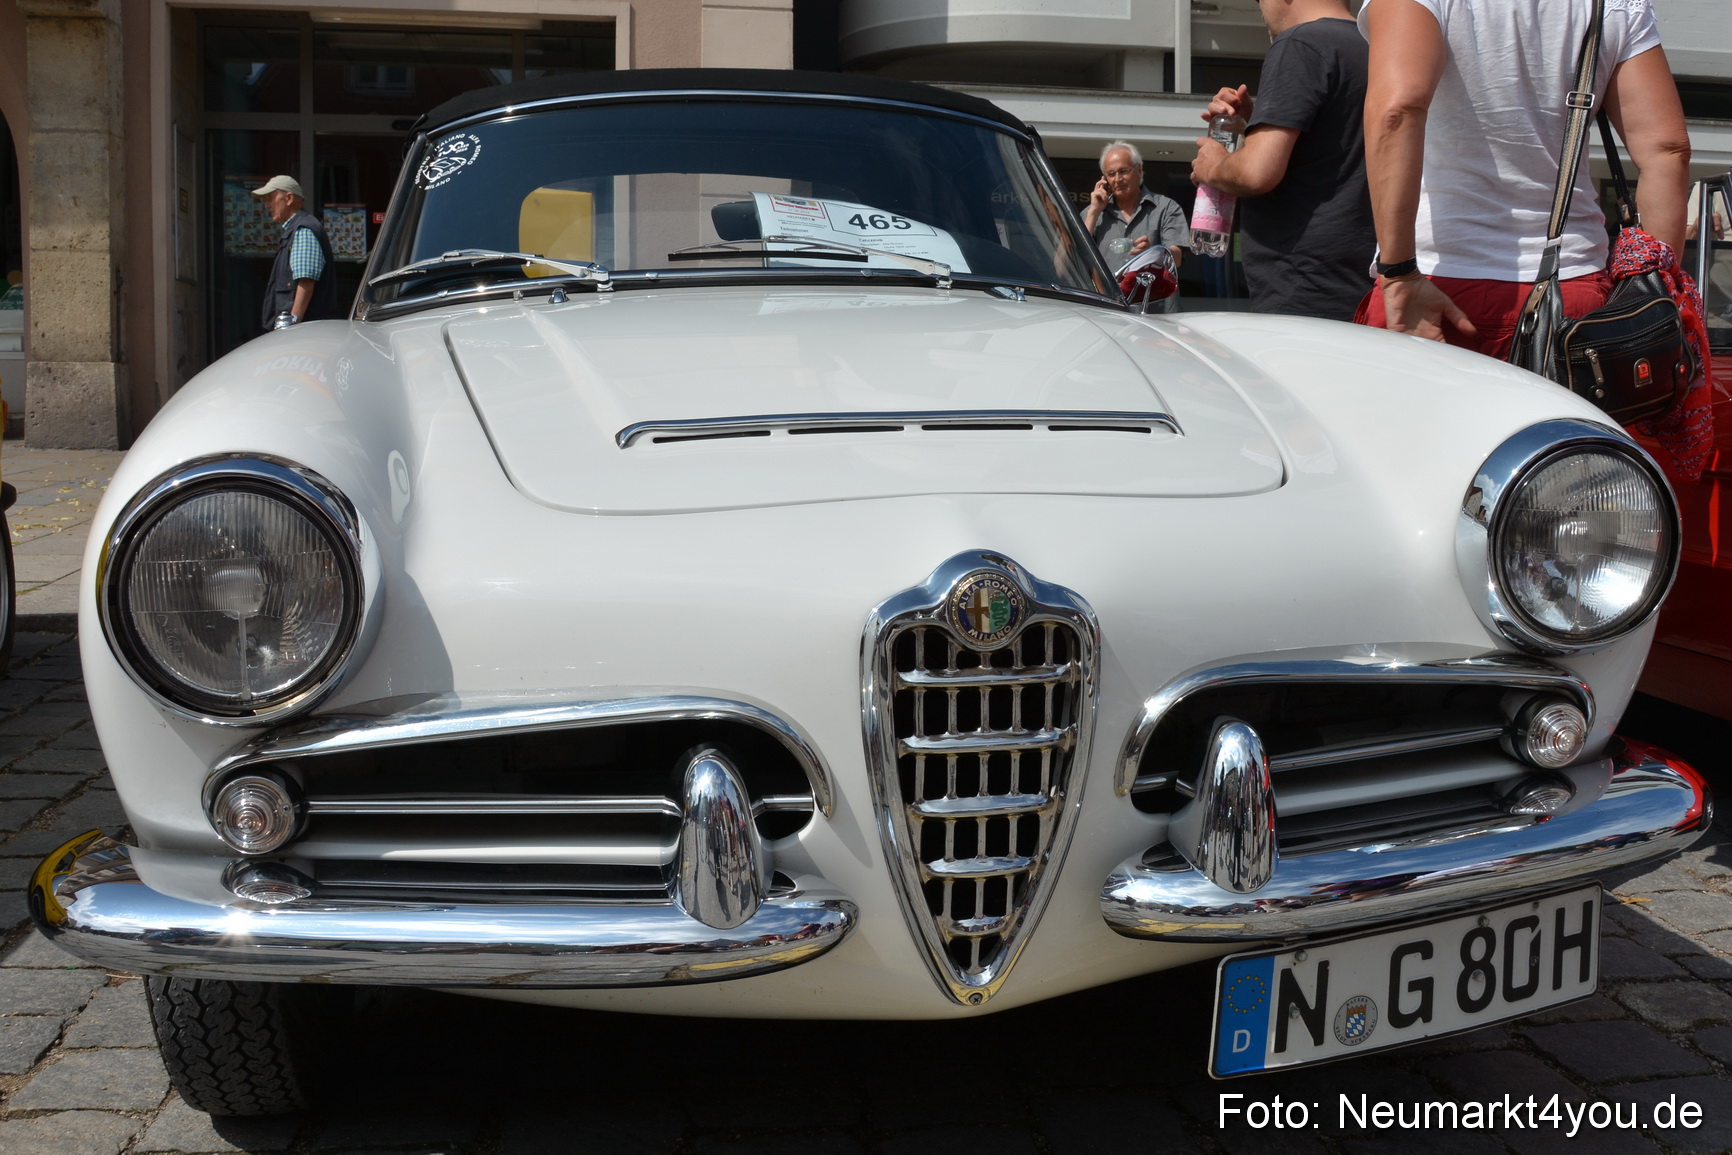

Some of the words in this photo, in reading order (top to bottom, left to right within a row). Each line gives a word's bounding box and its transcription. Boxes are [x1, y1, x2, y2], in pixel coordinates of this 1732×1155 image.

[434, 134, 465, 151] ITALIANO
[468, 134, 481, 144] ALFA
[424, 178, 450, 190] MILANO
[848, 213, 912, 230] 465
[968, 625, 1012, 641] MILANO
[1273, 960, 1330, 1054] N
[1387, 939, 1434, 1029] G
[1232, 1029, 1251, 1053] D
